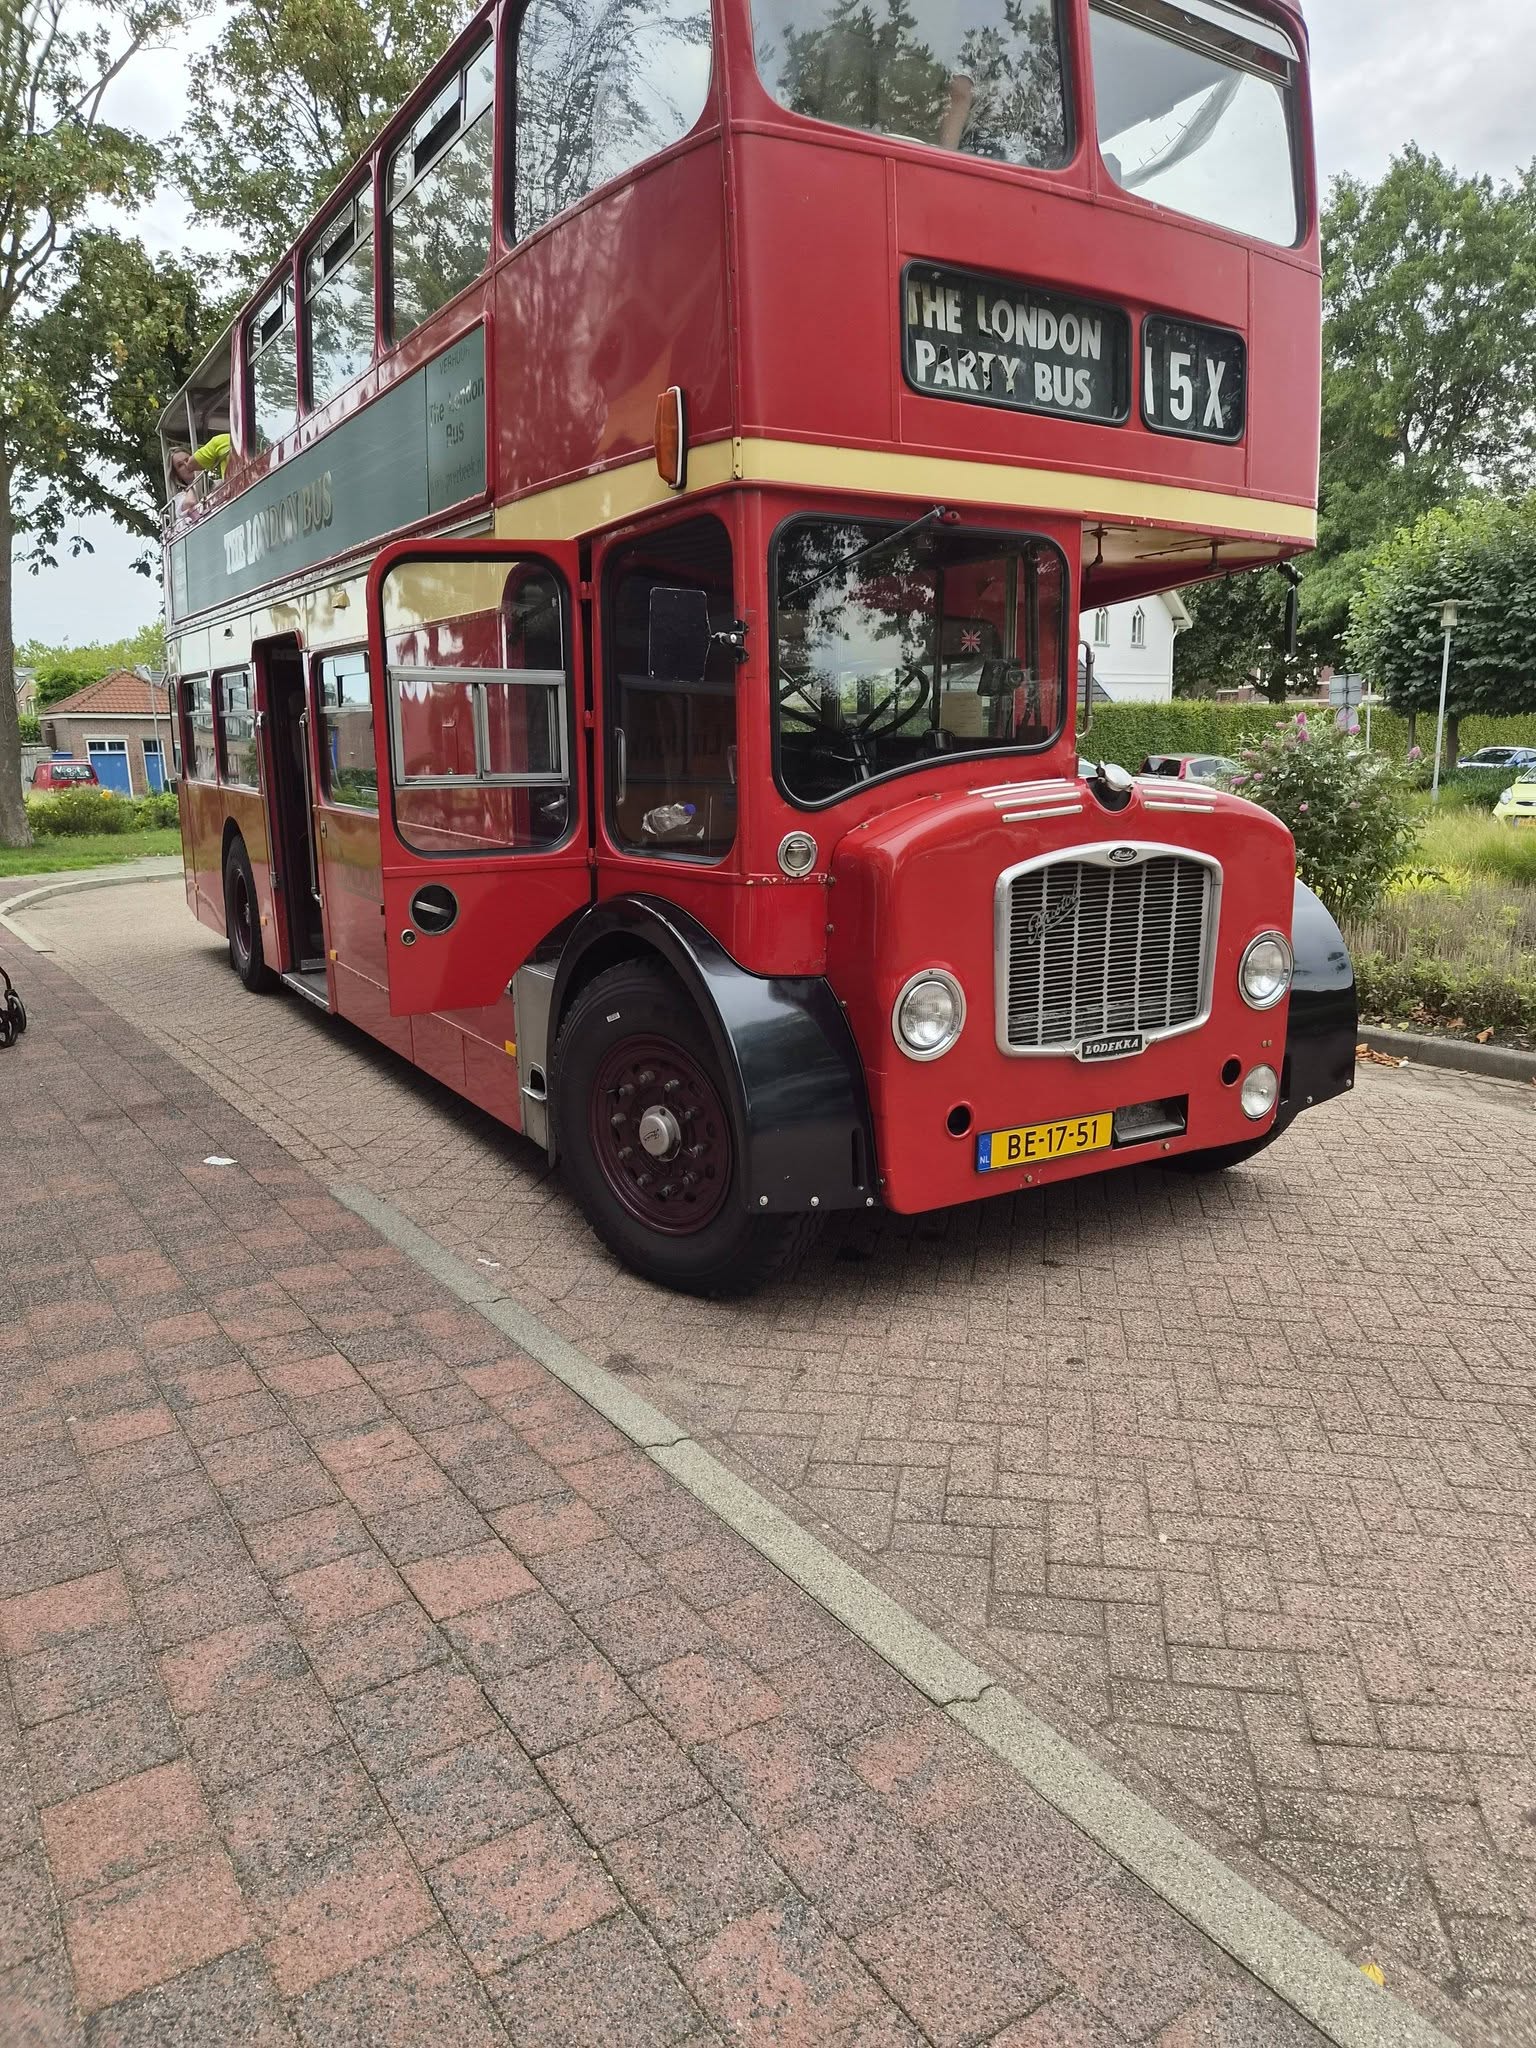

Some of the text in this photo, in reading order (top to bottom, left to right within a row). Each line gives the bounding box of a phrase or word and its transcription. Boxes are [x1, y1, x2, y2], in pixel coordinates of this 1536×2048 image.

[908, 280, 1101, 360] THE LONDON
[915, 339, 1092, 409] PARTY BUS
[1145, 345, 1226, 429] 15X
[446, 422, 465, 448] Bus
[224, 524, 247, 576] THE
[245, 490, 300, 566] LONDON
[301, 470, 333, 538] BUS
[1084, 1038, 1139, 1055] LODEKKA
[979, 1155, 990, 1164] NL
[1007, 1119, 1098, 1160] BE-17-51
